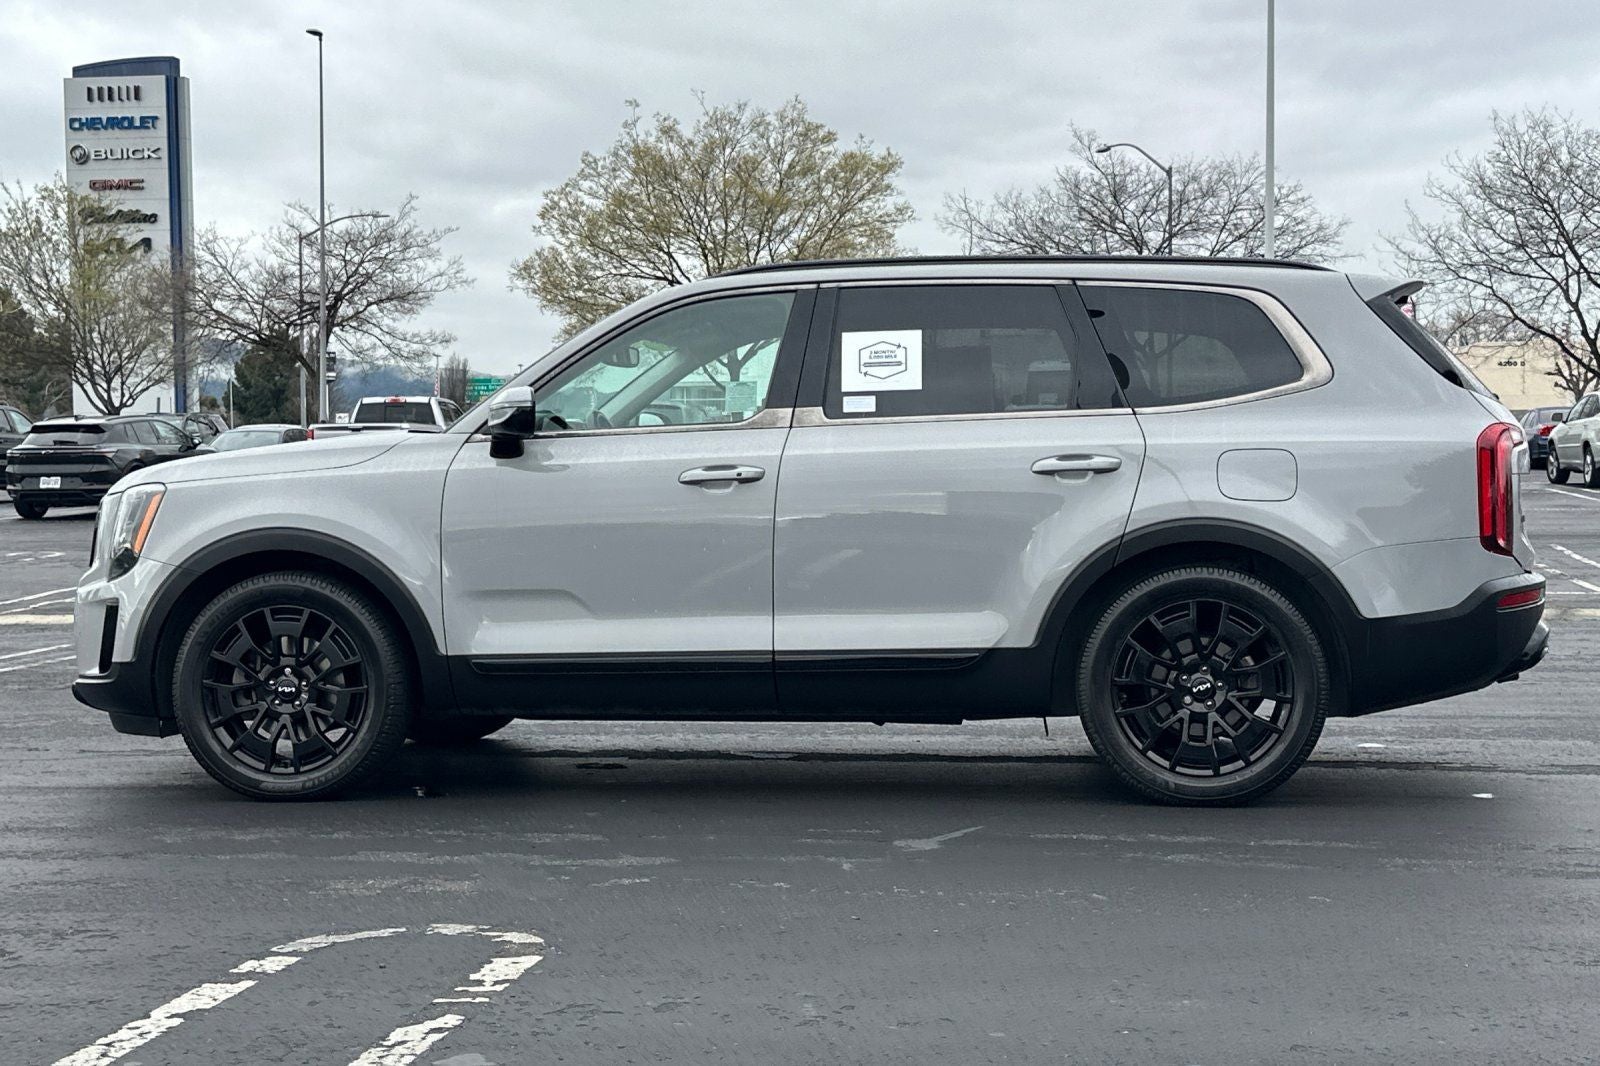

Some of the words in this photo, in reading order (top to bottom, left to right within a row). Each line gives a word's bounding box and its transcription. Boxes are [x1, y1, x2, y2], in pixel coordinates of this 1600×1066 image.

[69, 115, 159, 131] CHEVROLET
[91, 147, 162, 160] BUICK
[89, 179, 145, 191] GMC
